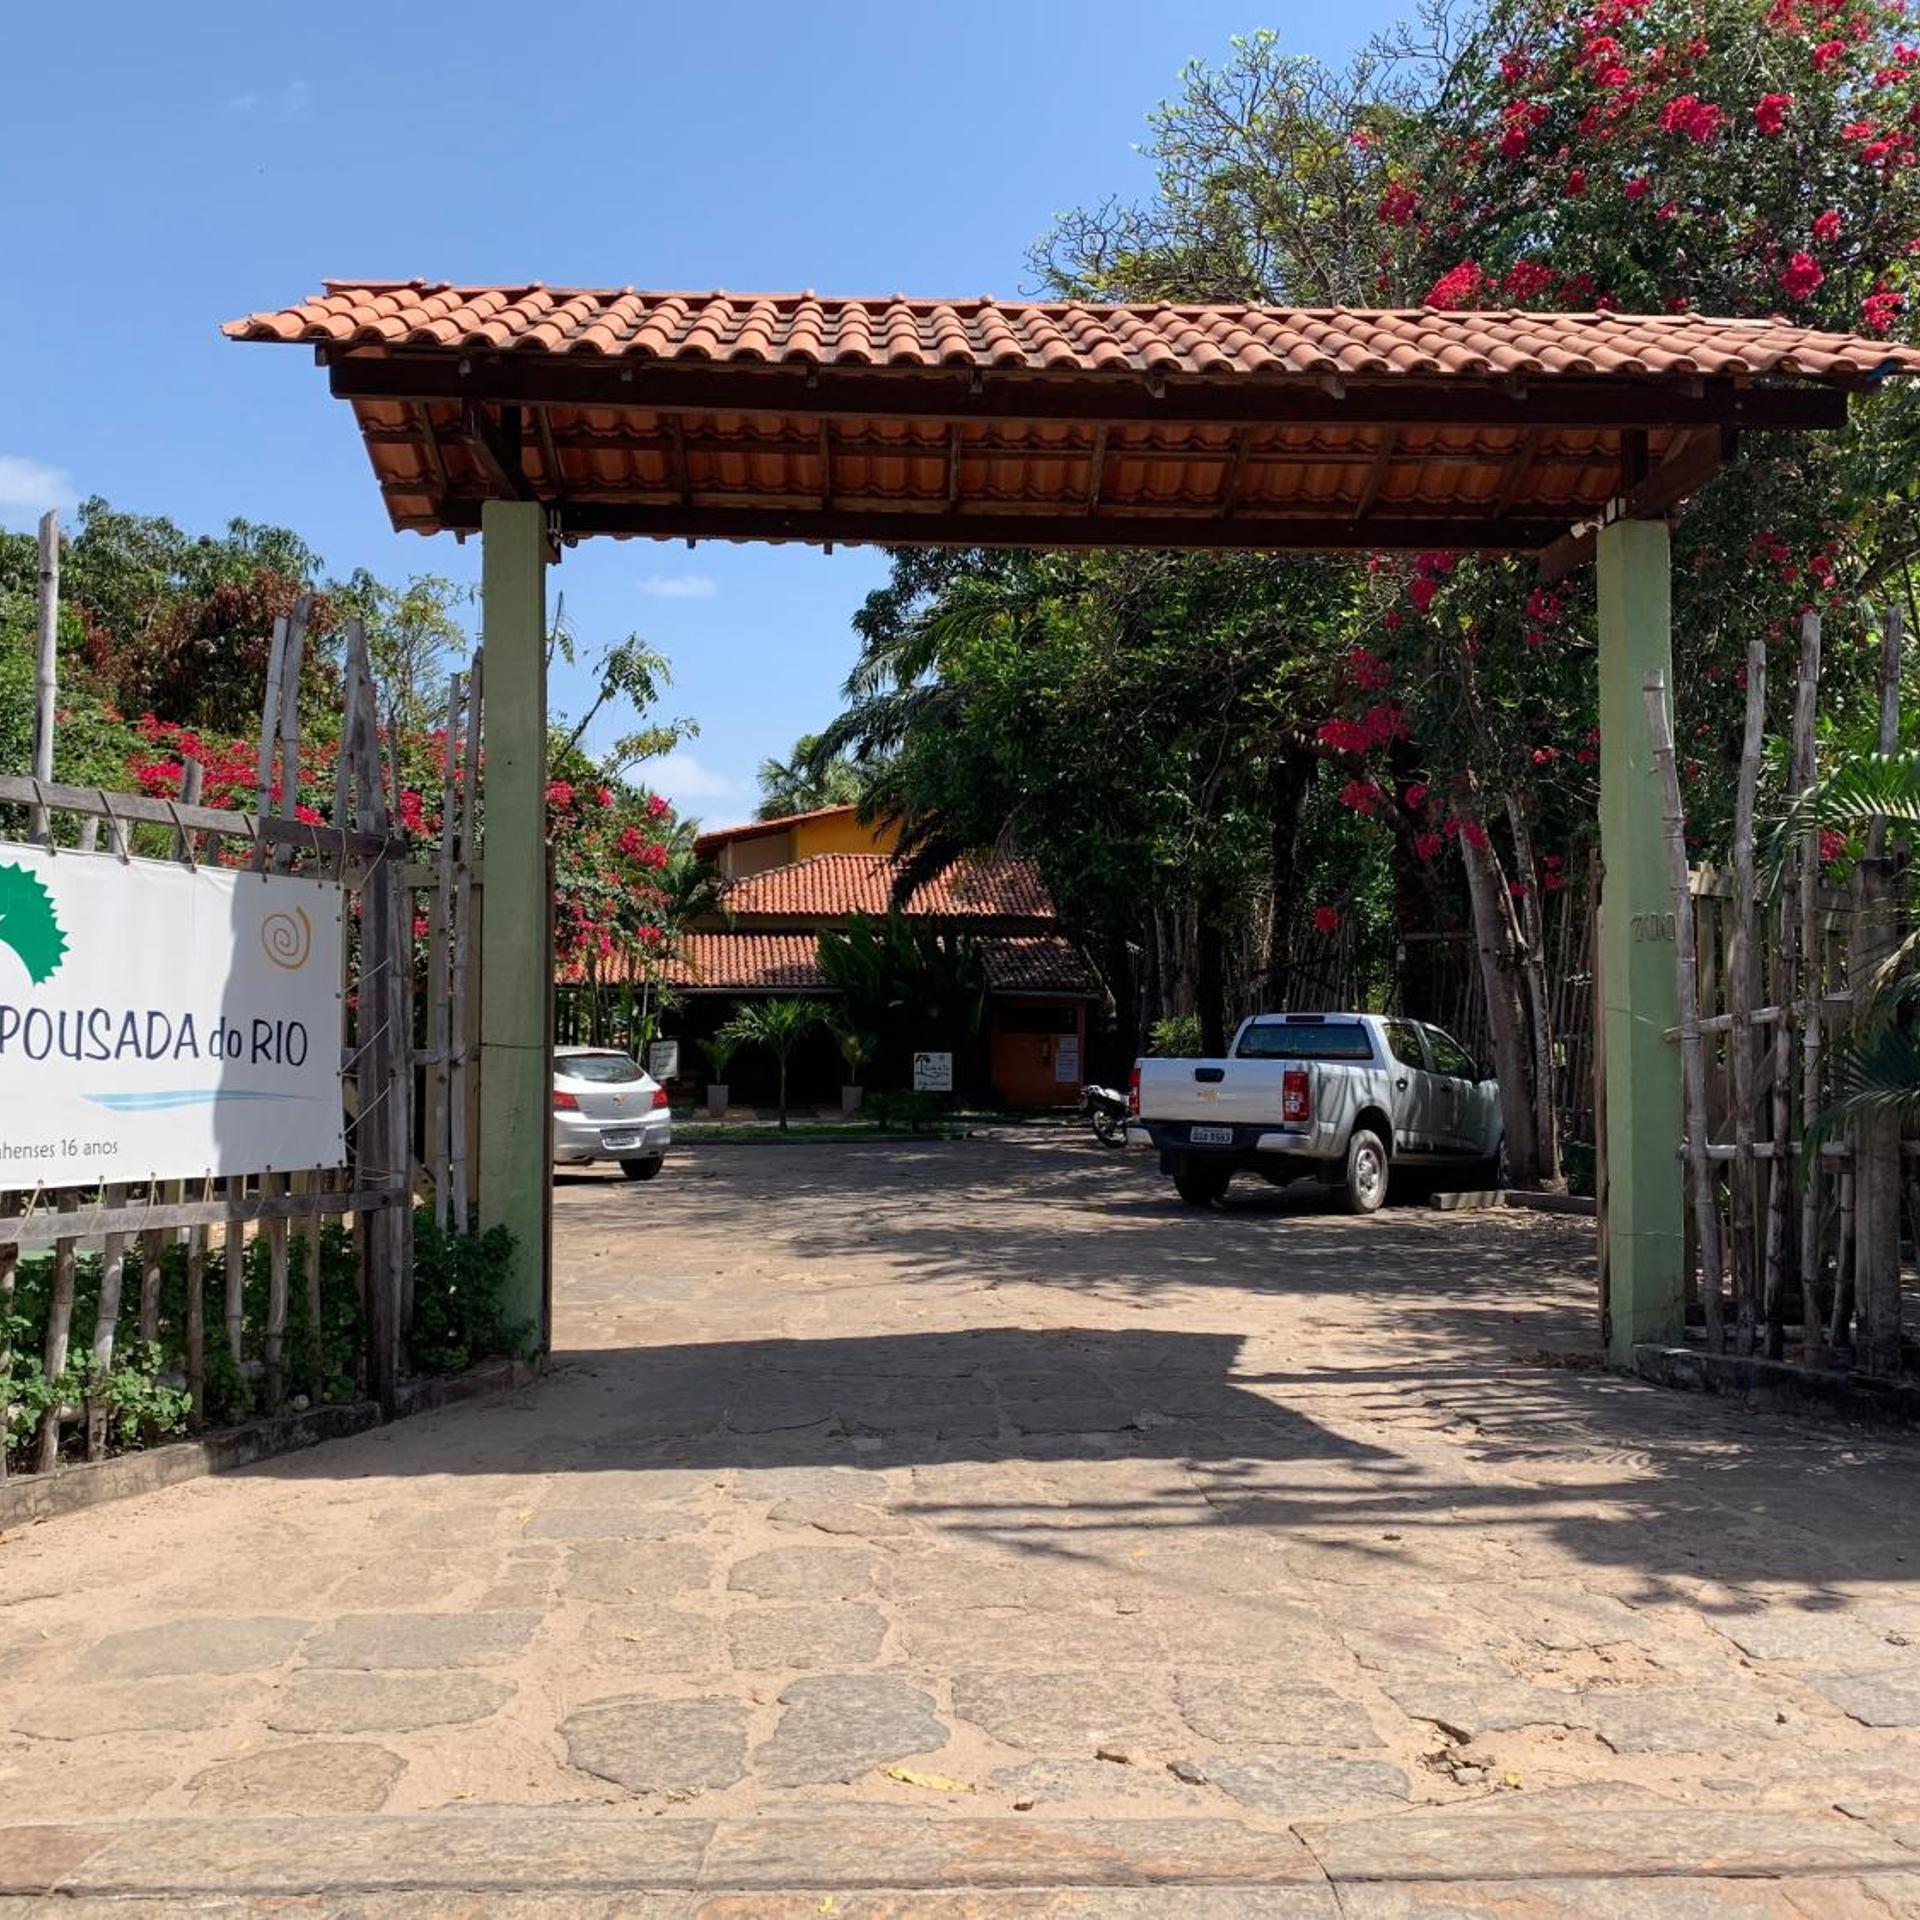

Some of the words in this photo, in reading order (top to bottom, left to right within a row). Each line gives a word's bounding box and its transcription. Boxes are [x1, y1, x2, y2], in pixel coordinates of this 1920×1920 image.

[0, 1005, 200, 1060] POUSADA
[209, 1016, 243, 1060] do
[251, 1018, 308, 1067] RIO
[61, 1139, 78, 1157] 16
[83, 1140, 118, 1156] anos
